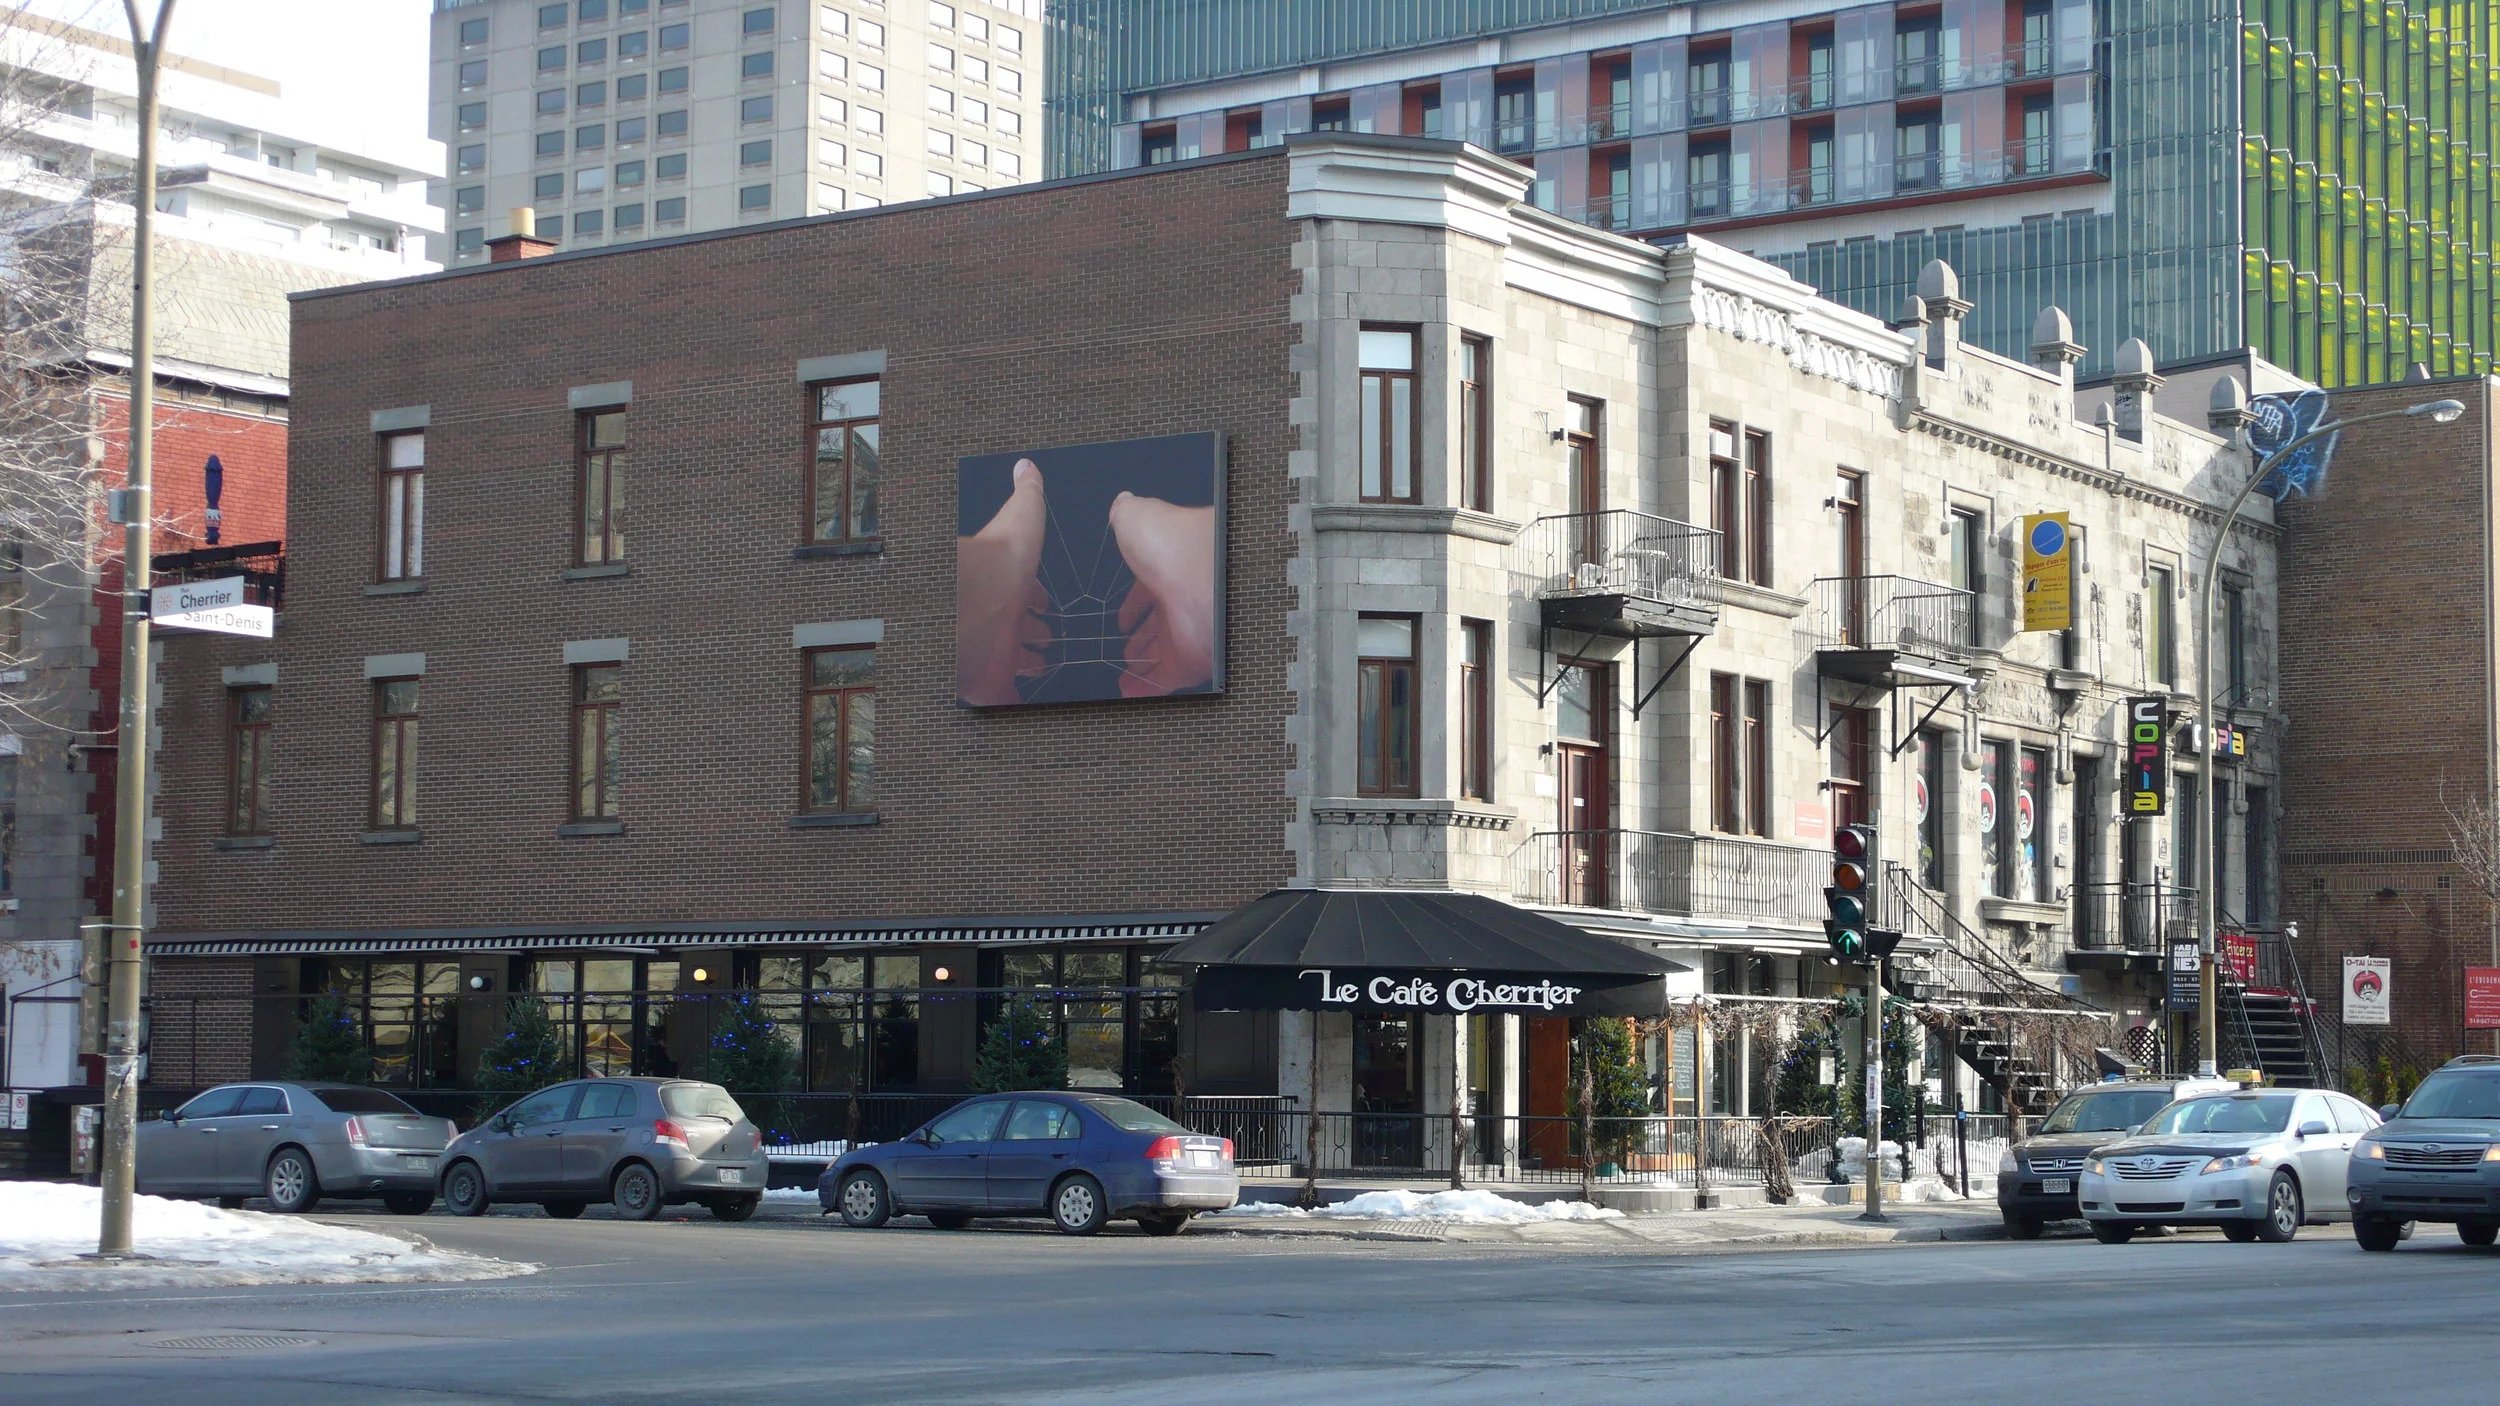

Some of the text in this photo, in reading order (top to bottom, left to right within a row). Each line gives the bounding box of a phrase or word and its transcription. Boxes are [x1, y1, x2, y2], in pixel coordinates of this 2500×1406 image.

[180, 591, 232, 609] Cherrier
[183, 612, 263, 630] Saint-Denis
[1299, 969, 1582, 1011] Le Café Cherrier
